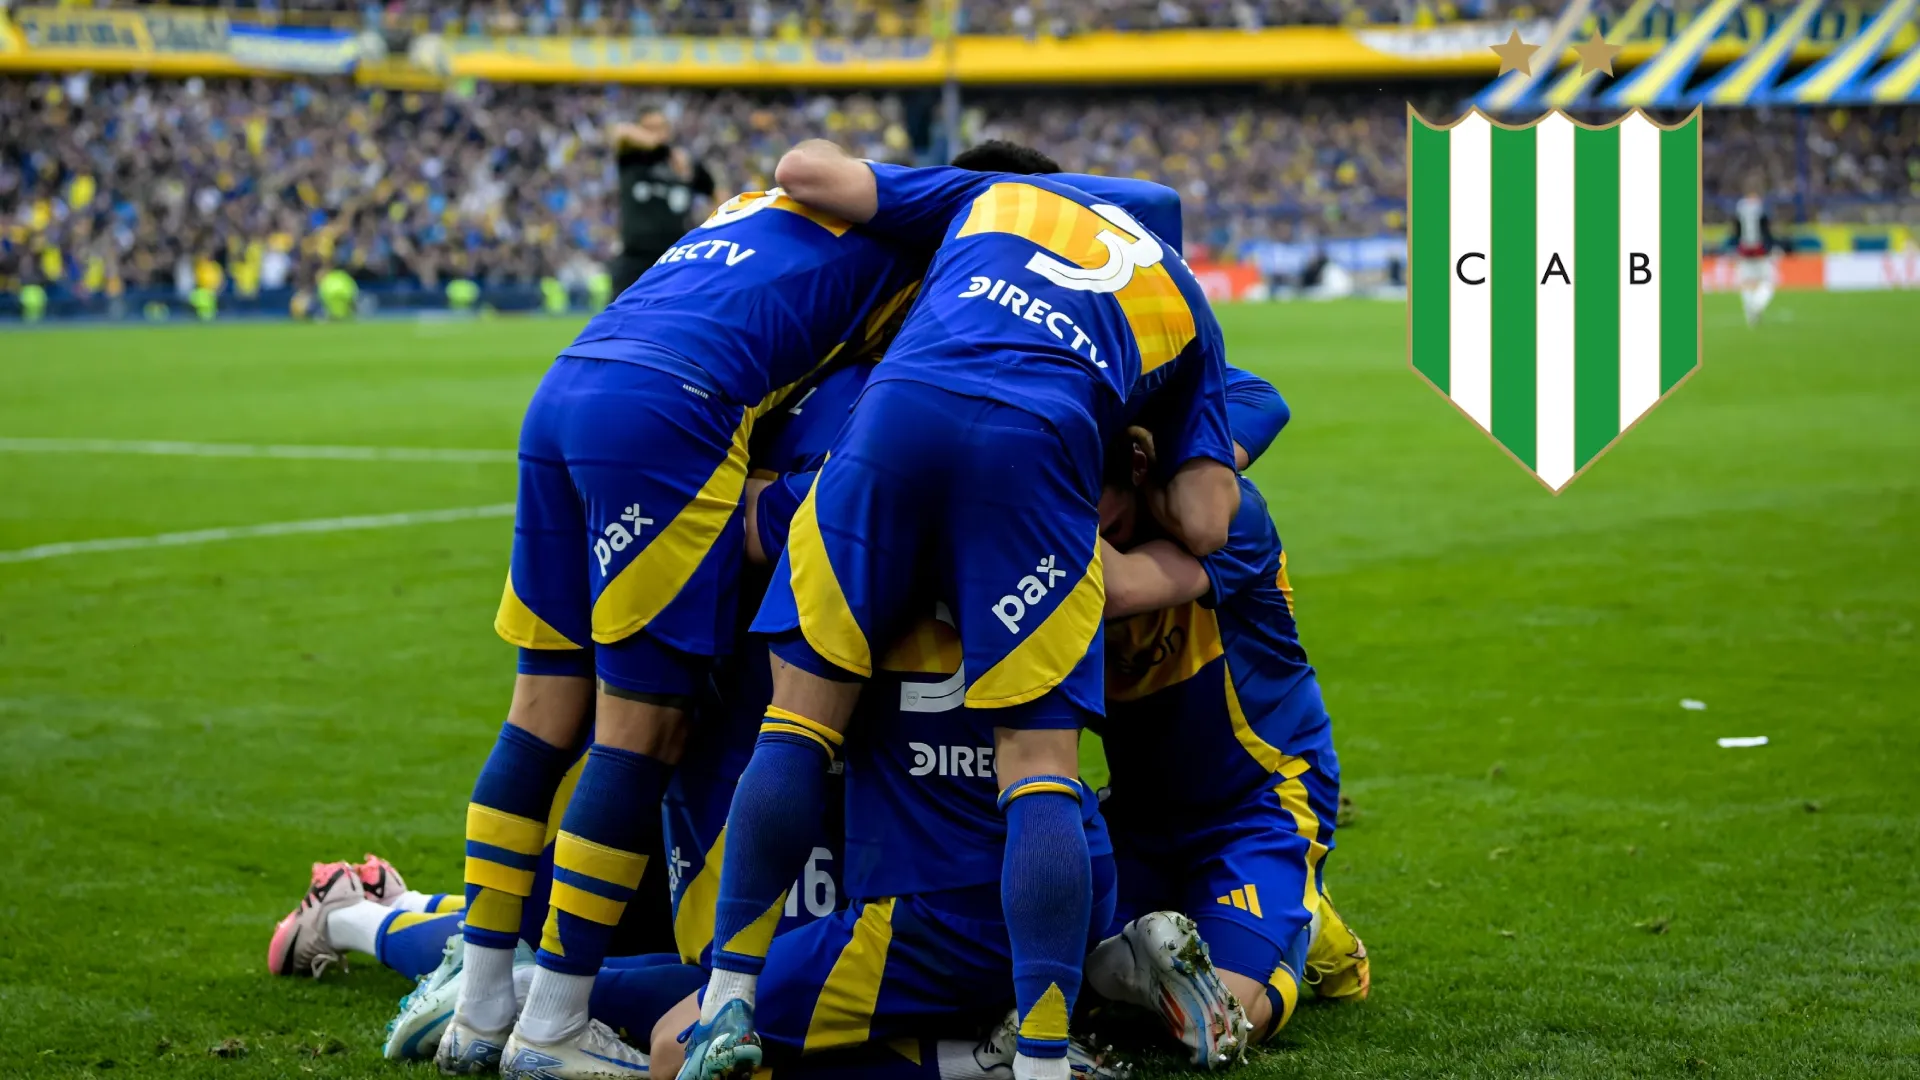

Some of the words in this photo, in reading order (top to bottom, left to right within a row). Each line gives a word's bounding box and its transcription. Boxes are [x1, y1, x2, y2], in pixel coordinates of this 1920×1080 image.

[653, 239, 756, 267] RECTV
[1025, 203, 1164, 294] 3
[957, 276, 1109, 369] DIRECTV
[593, 503, 654, 578] pax
[991, 554, 1067, 635] pax
[908, 742, 998, 778] DIRE
[667, 846, 691, 905] ax
